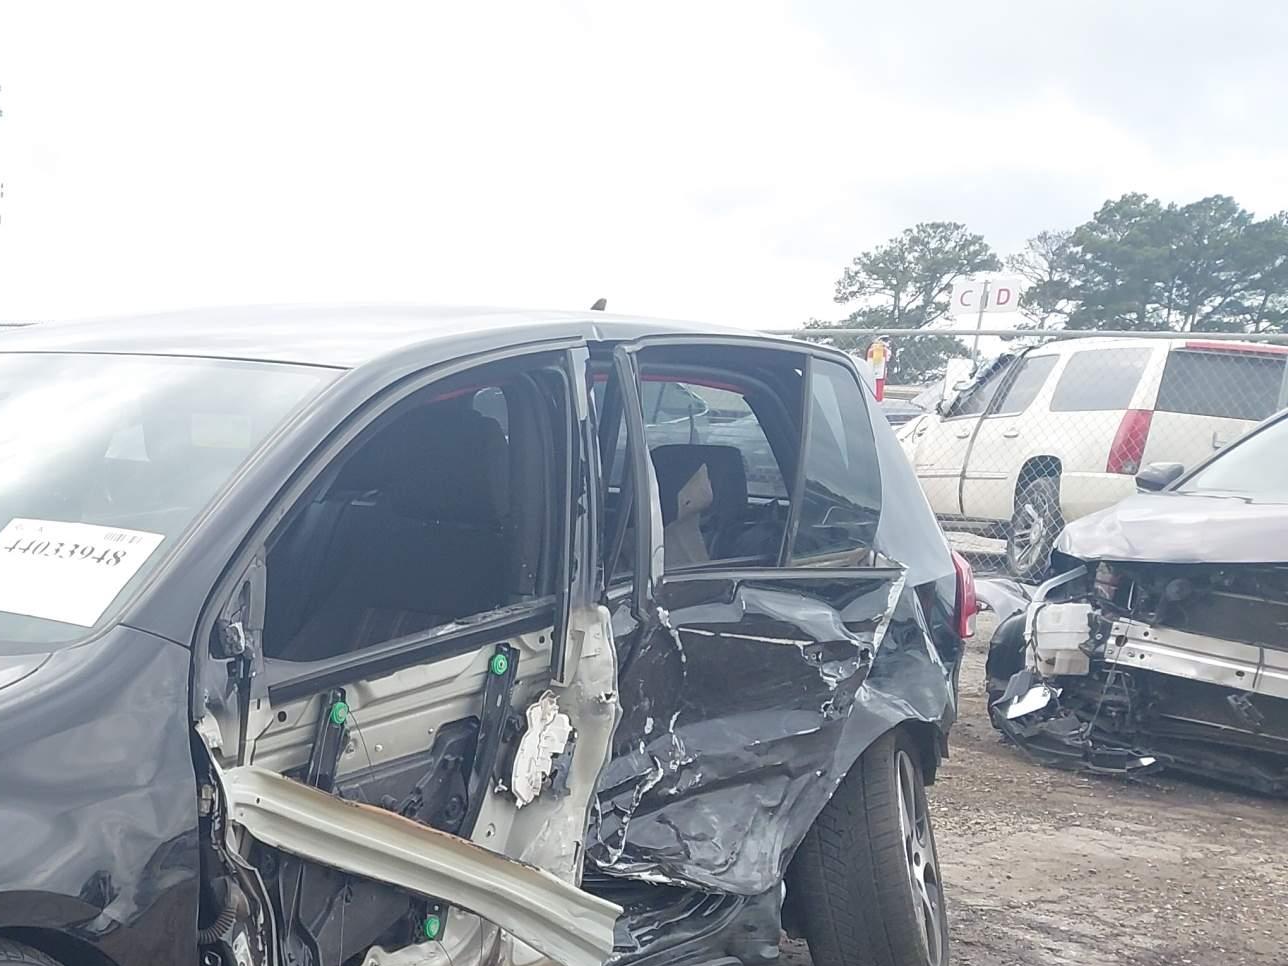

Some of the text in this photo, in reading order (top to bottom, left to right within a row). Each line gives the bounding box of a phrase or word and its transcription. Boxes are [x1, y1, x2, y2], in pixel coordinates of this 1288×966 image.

[959, 289, 973, 307] C
[996, 288, 1011, 306] D
[4, 538, 127, 567] 44033948
